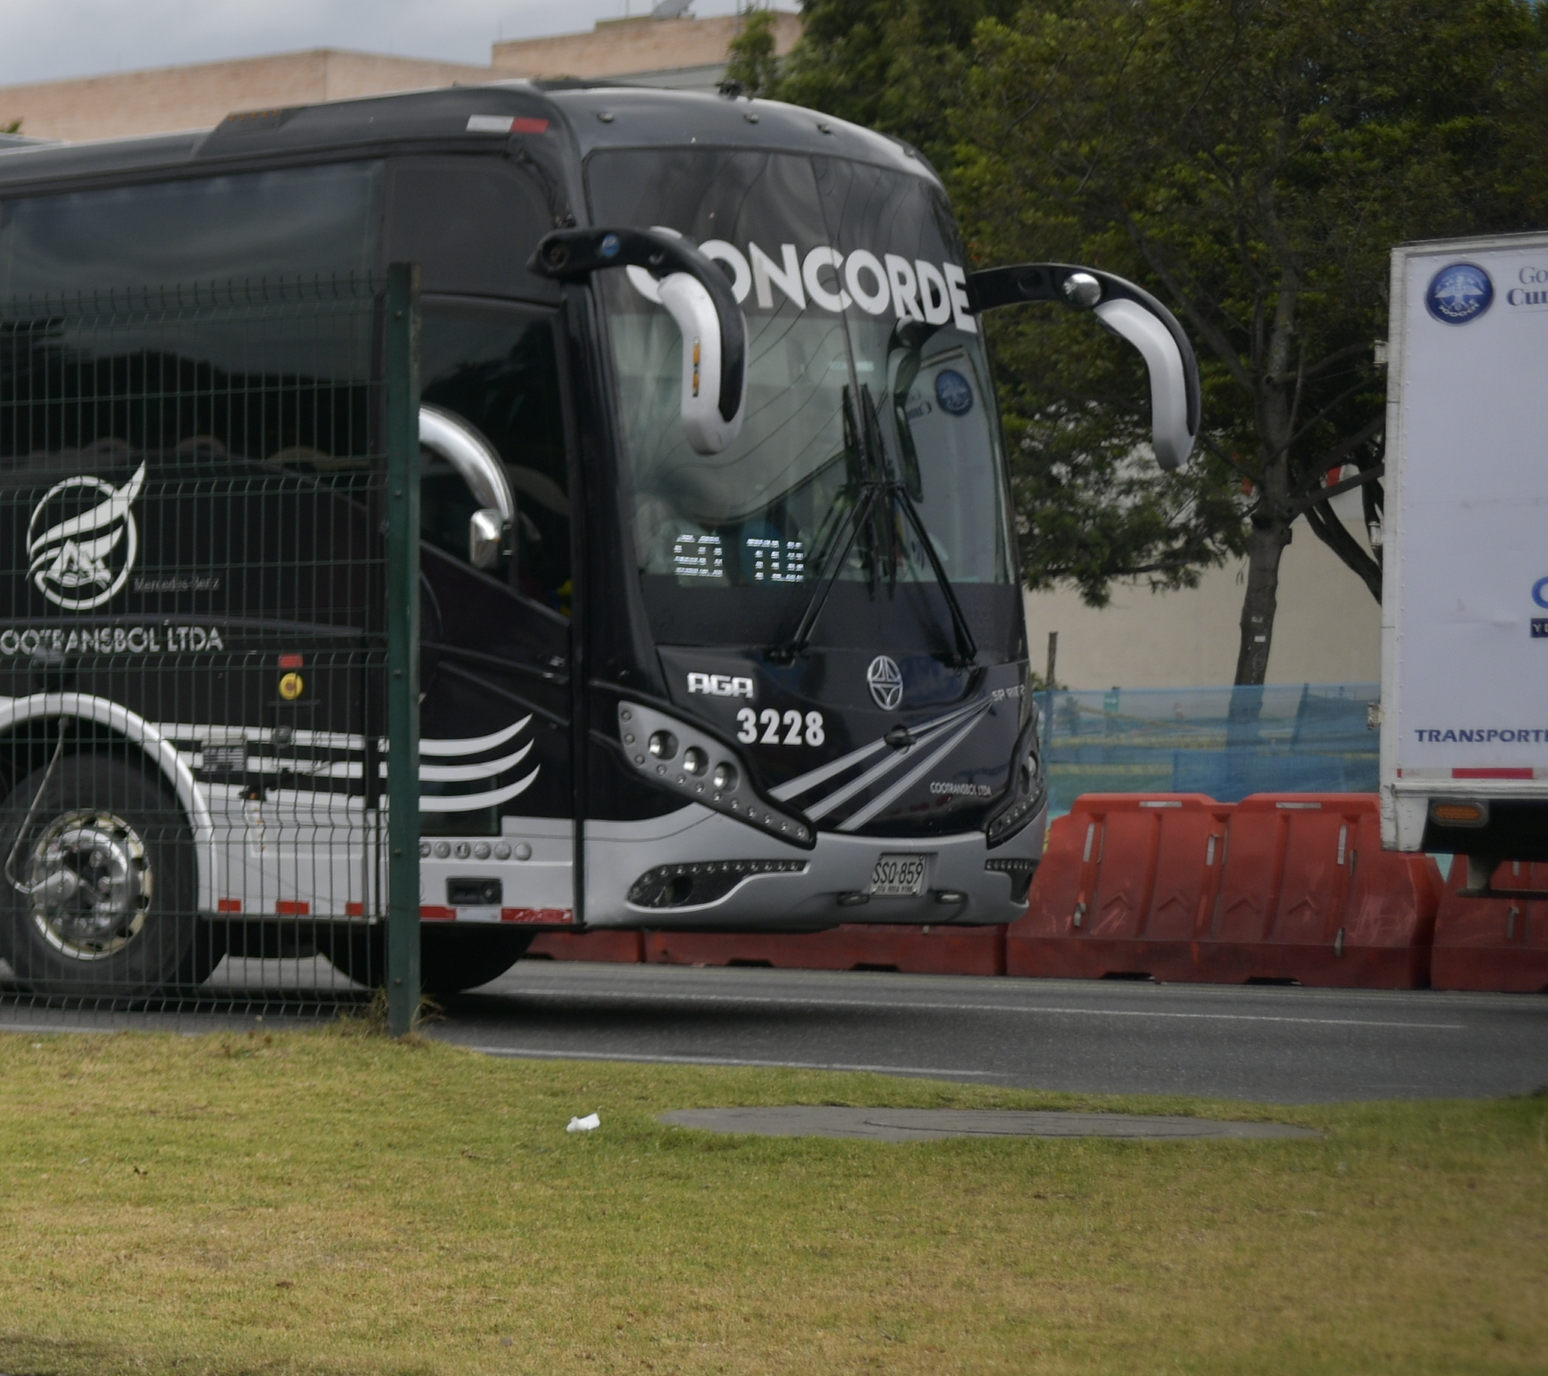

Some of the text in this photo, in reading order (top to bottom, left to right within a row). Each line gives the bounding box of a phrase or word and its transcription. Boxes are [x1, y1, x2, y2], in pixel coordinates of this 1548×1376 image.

[167, 626, 224, 653] LTDA
[687, 672, 754, 699] AGA
[736, 708, 826, 748] 3228
